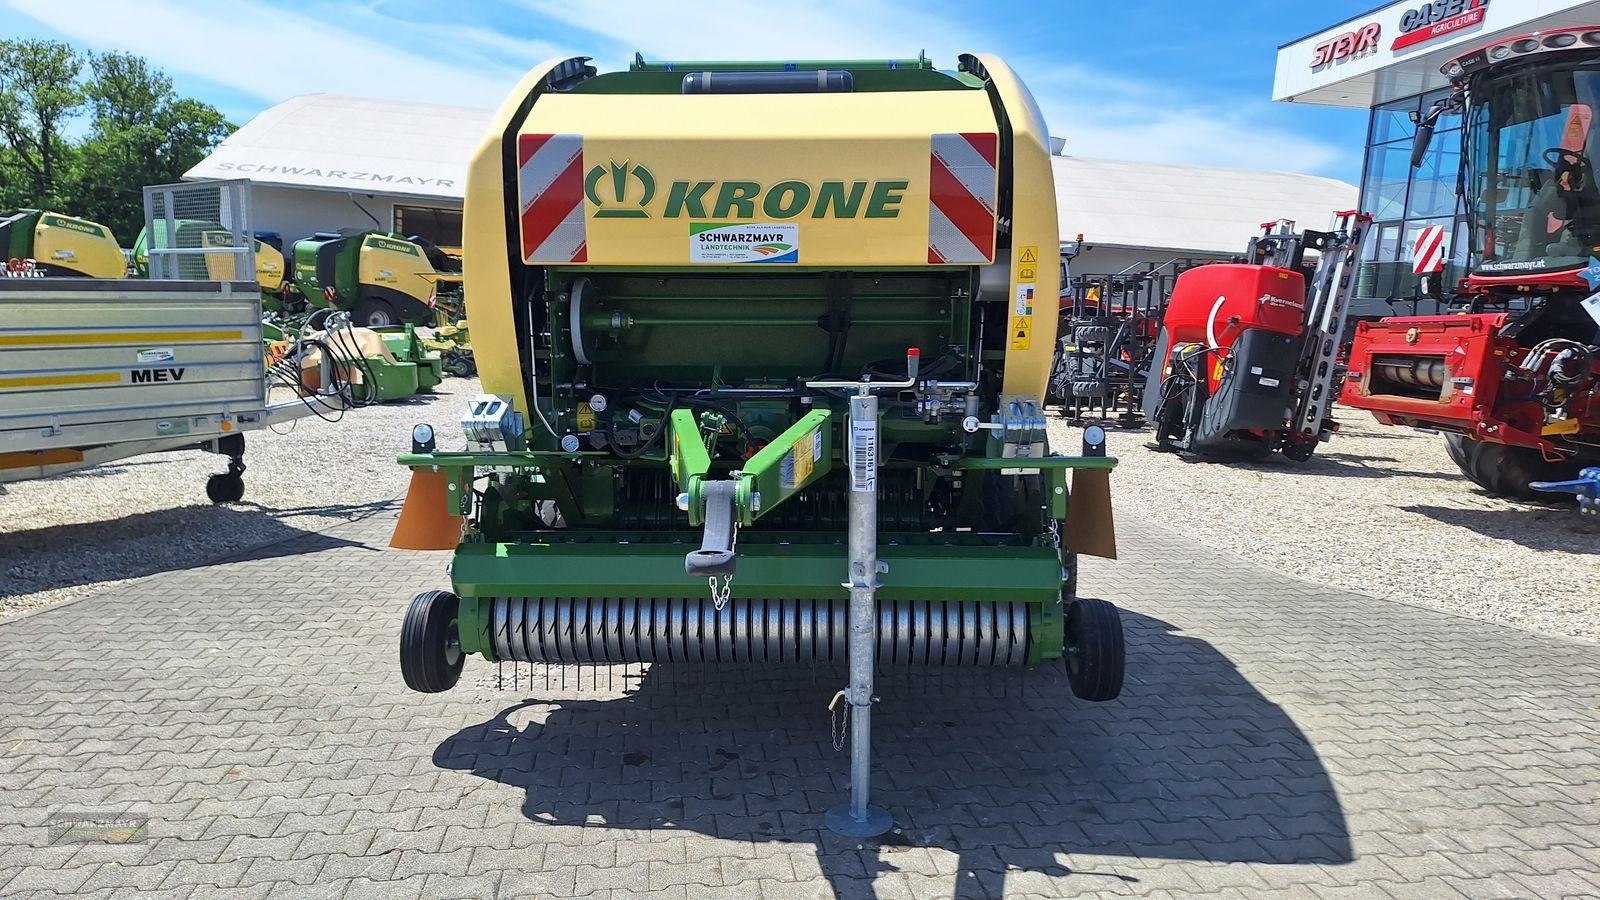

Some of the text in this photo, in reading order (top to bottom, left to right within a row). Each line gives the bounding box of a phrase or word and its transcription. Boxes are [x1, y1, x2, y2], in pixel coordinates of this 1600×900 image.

[1431, 12, 1479, 35] AGRICULTURE
[1309, 22, 1381, 69] STEYR
[215, 162, 456, 188] SCHWARZMAYR
[663, 180, 910, 219] KRONE
[66, 222, 96, 233] KRONE
[699, 233, 784, 242] SCHWARZMAYR
[386, 243, 411, 253] KRONE
[1480, 258, 1546, 271] www.schwarzmayr.at
[131, 368, 185, 383] MEV
